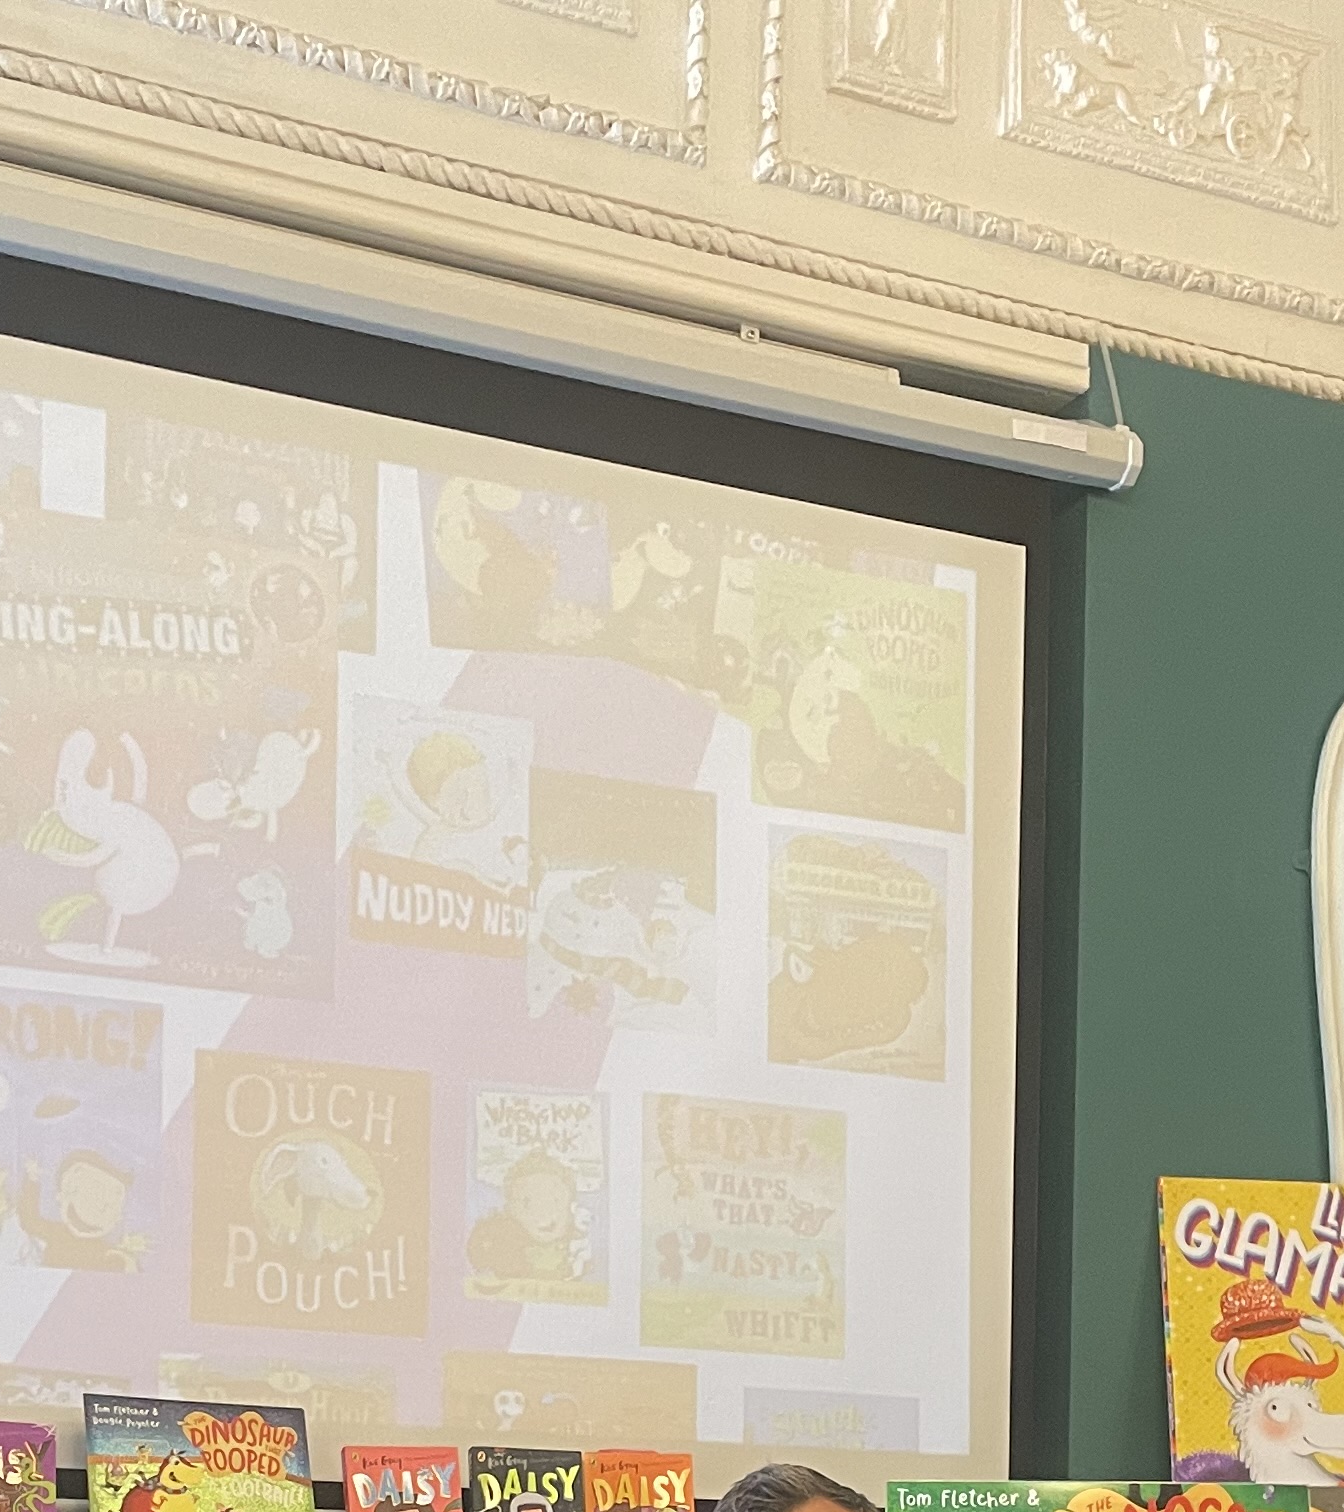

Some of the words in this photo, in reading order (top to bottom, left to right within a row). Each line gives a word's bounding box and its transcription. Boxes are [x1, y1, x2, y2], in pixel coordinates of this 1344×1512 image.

[865, 634, 941, 673] POOPED
[225, 1073, 397, 1145] OUCH
[712, 1200, 775, 1229] THAT
[223, 1223, 408, 1314] POUCH!
[711, 1240, 798, 1280] NASTY
[93, 1403, 110, 1415] Tom
[189, 1415, 296, 1448] DINOSAUR
[201, 1447, 281, 1478] POOPED
[351, 1462, 456, 1510] DAISY
[477, 1465, 580, 1510] DAISY
[592, 1467, 691, 1512] DAISY
[896, 1488, 936, 1509] Tom
[941, 1487, 1020, 1509] Fletcher
[1026, 1489, 1040, 1506] &
